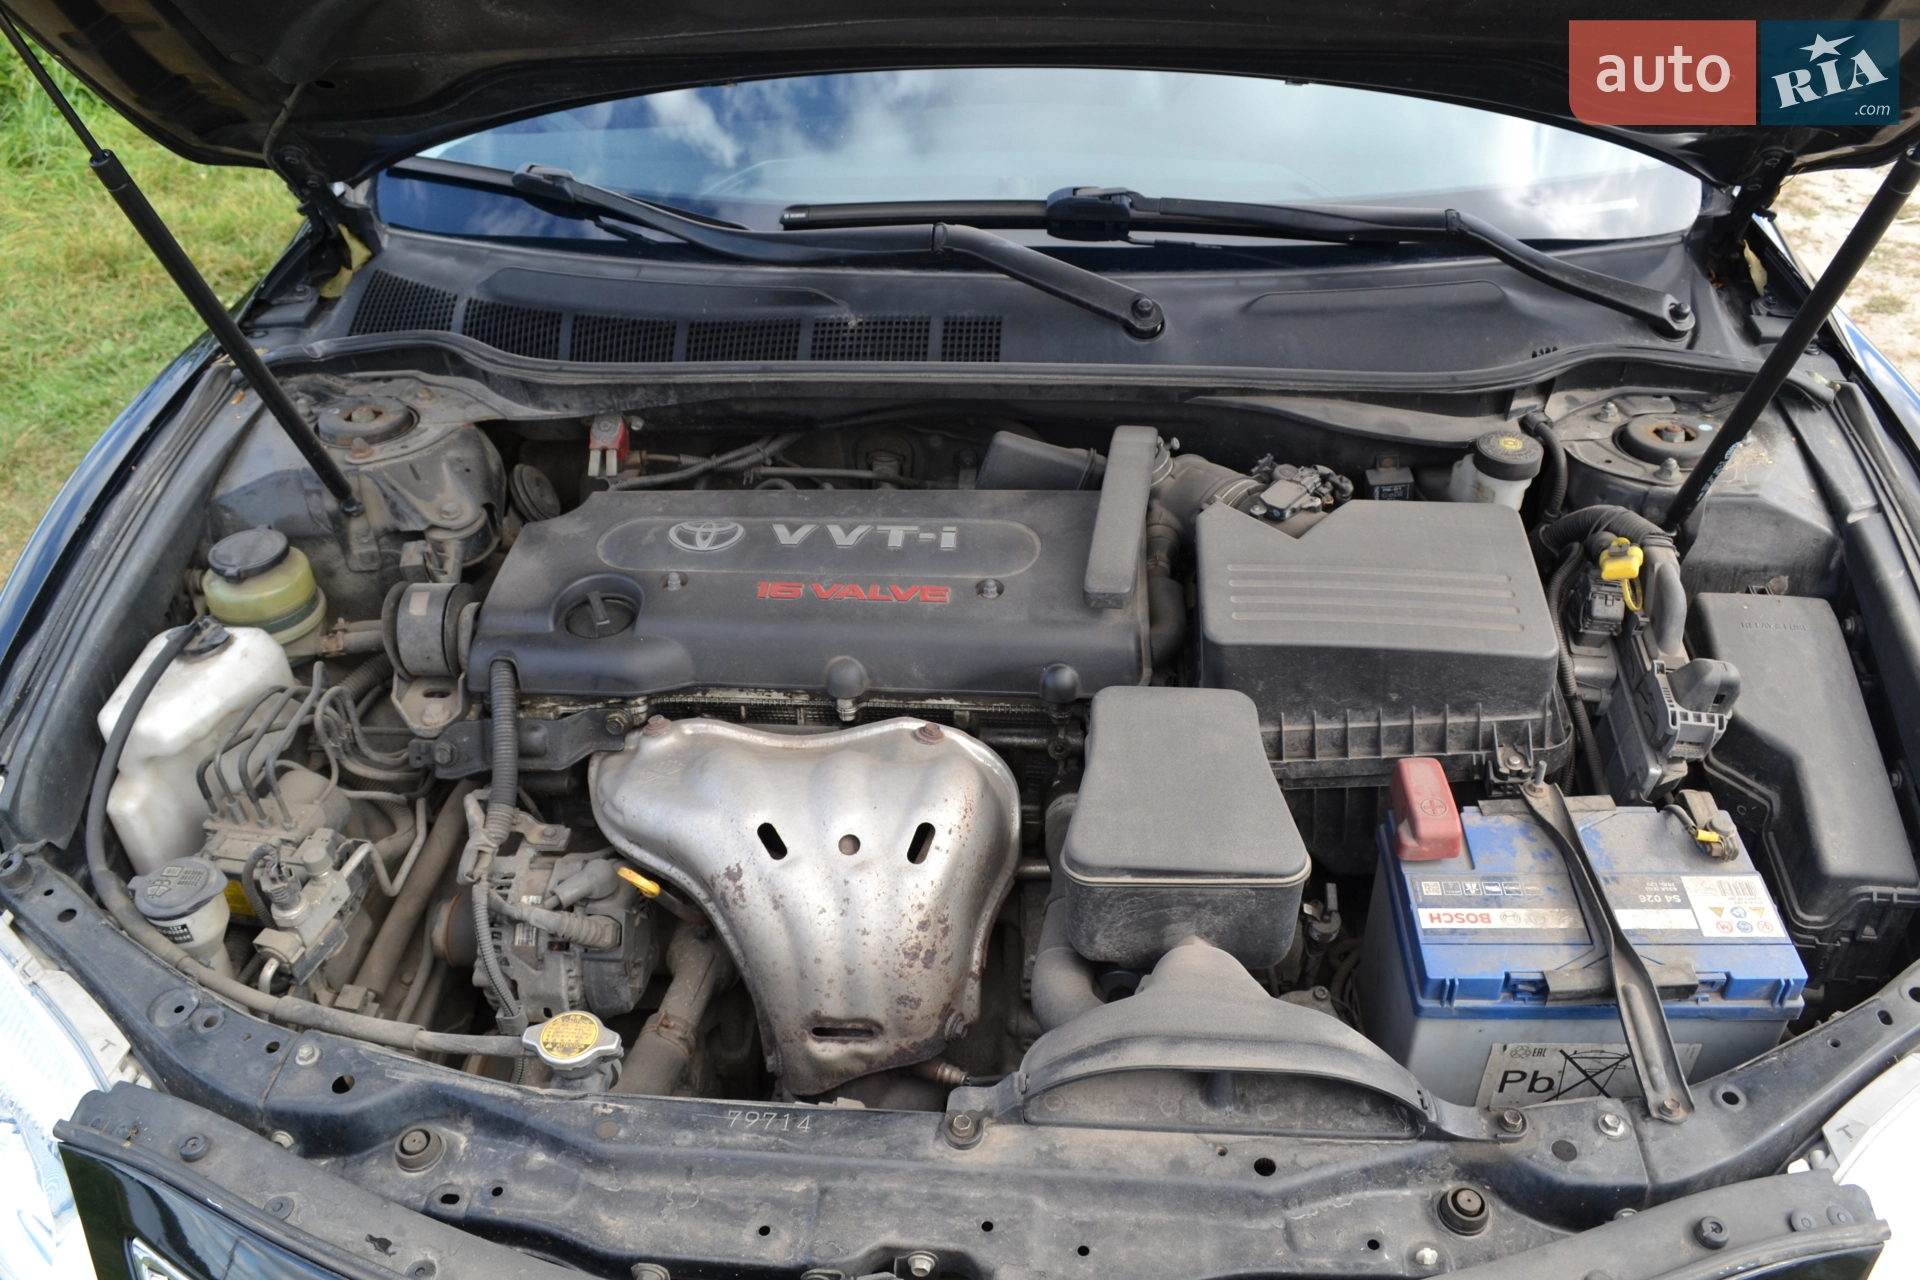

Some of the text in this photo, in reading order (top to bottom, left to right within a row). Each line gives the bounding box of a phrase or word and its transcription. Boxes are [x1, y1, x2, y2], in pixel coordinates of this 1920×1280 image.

[771, 523, 957, 549] VVT-i
[757, 581, 949, 603] 16 VALVE
[1638, 894, 1682, 903] S4 026
[1428, 912, 1492, 924] BOSCH
[1498, 1070, 1554, 1094] Pb
[728, 1110, 811, 1133] 79714
